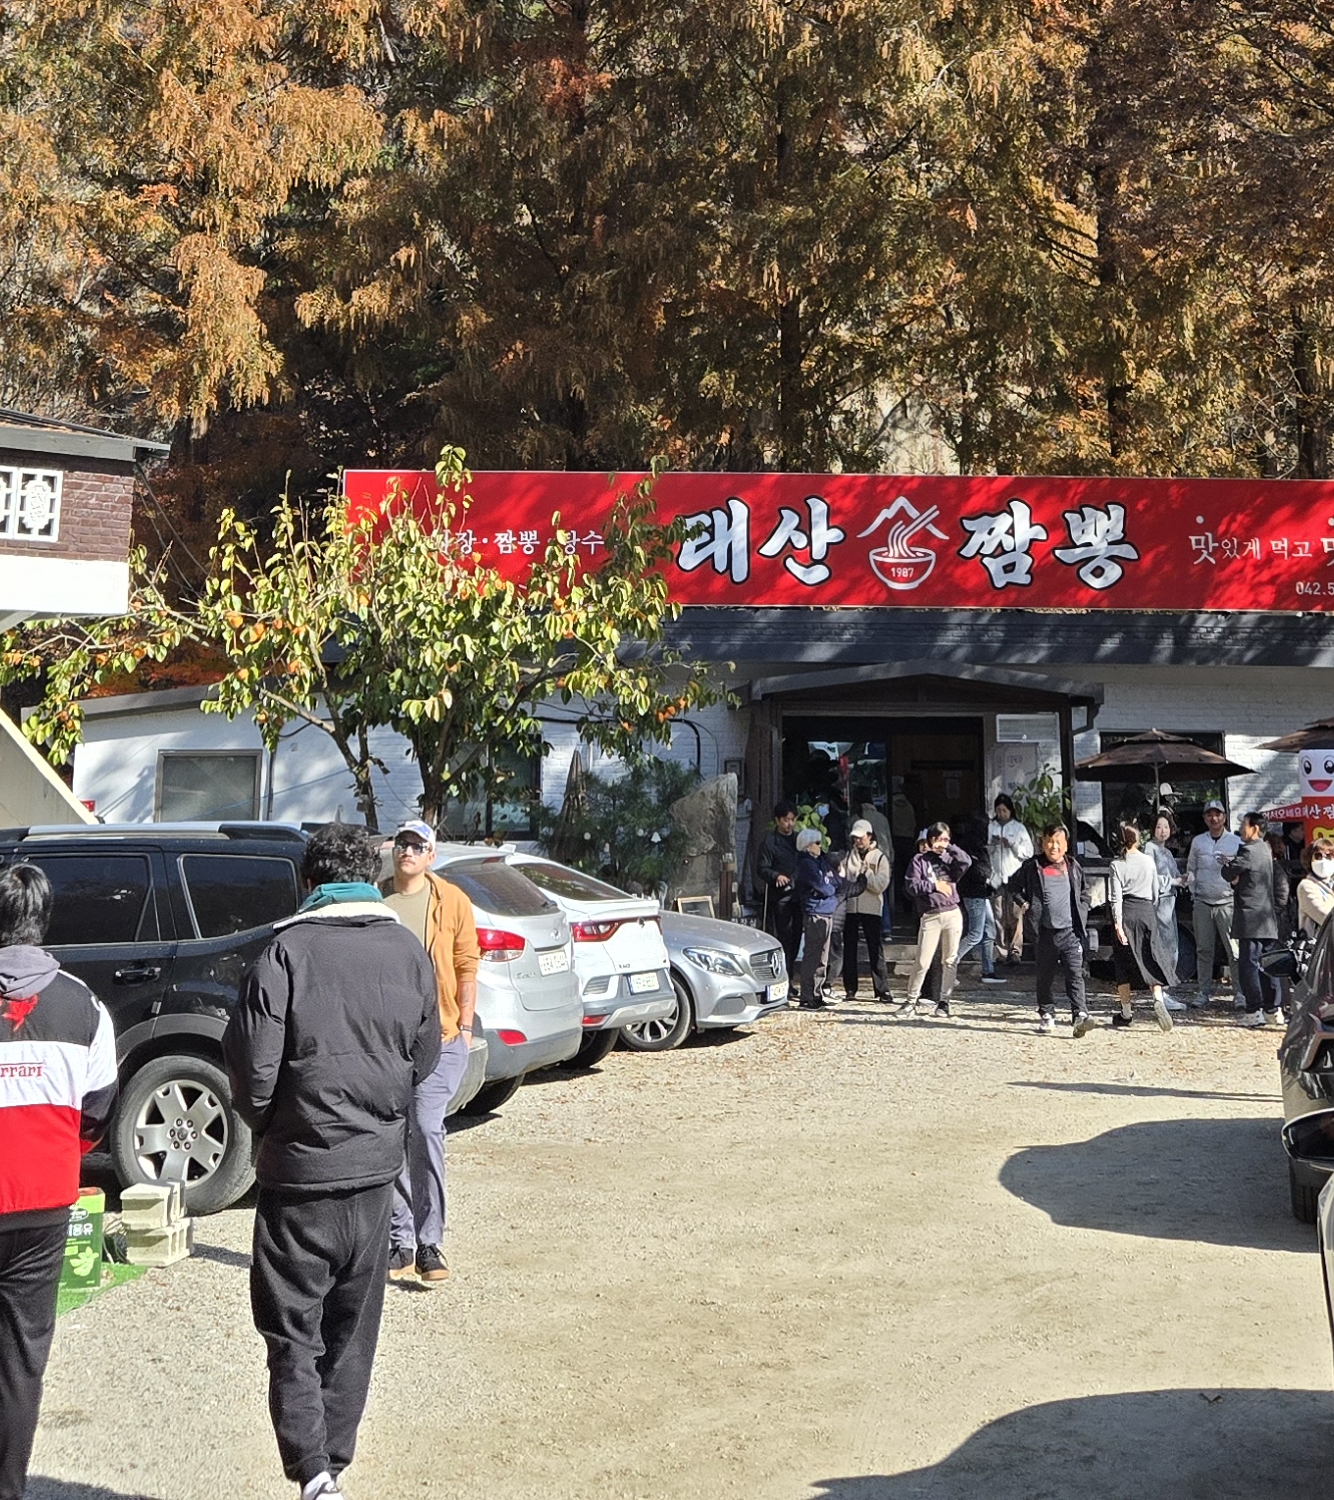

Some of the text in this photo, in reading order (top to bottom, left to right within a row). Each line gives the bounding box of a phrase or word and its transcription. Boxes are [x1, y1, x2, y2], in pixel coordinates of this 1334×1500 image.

[678, 497, 1140, 590] 태산 짬뽕
[1188, 532, 1261, 565] 맛있게
[1270, 537, 1313, 560] 먹고
[890, 567, 914, 578] 1987
